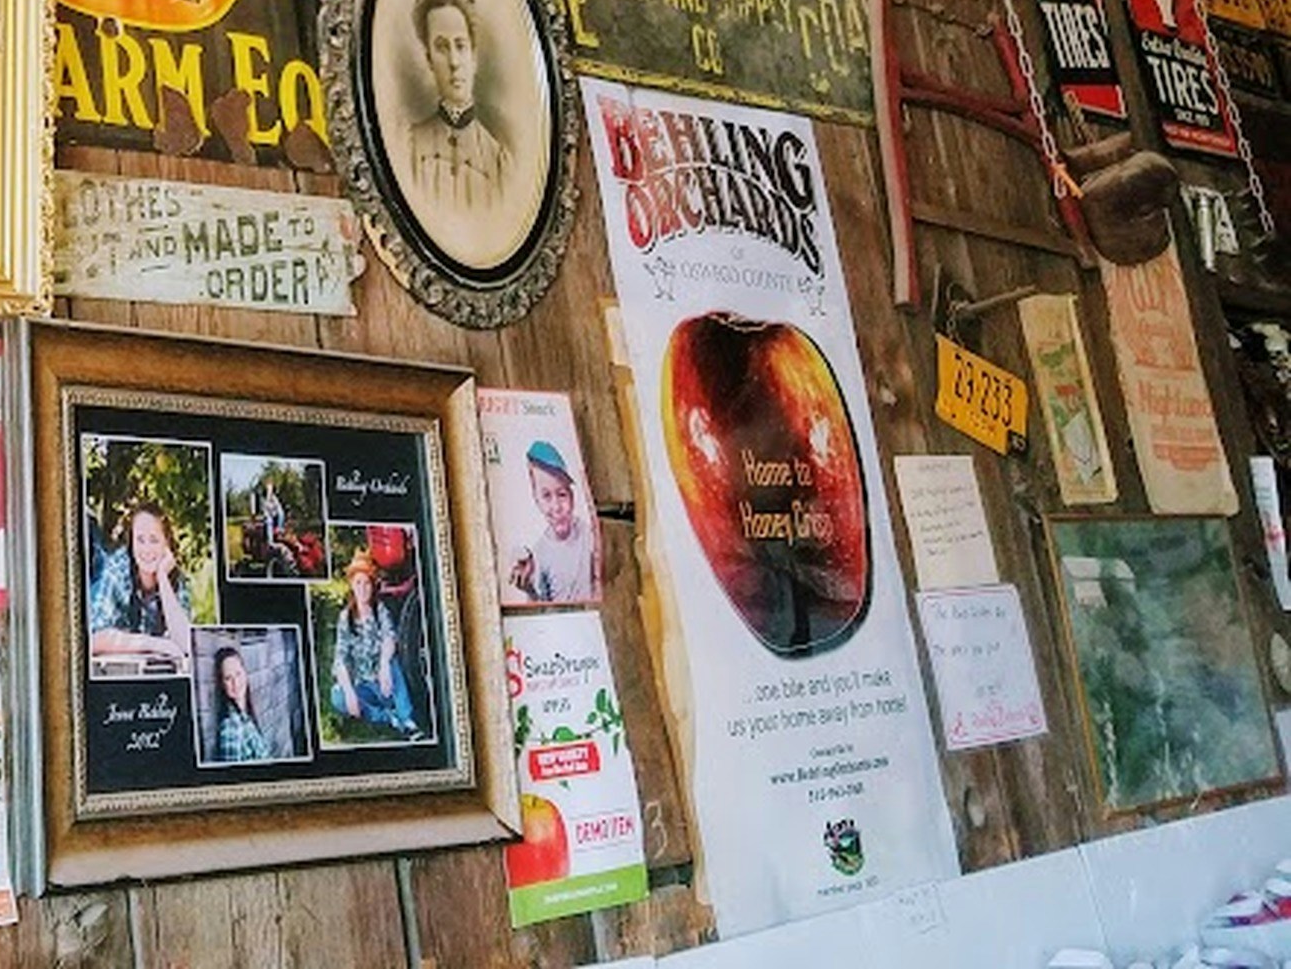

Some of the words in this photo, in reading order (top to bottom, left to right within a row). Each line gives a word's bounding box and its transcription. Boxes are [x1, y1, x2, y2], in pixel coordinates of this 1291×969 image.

[1040, 0, 1111, 70] TIRES
[1146, 55, 1219, 115] TIRES
[596, 94, 816, 211] BEHLING
[181, 211, 284, 265] MADE
[625, 166, 825, 279] ORCHARDS
